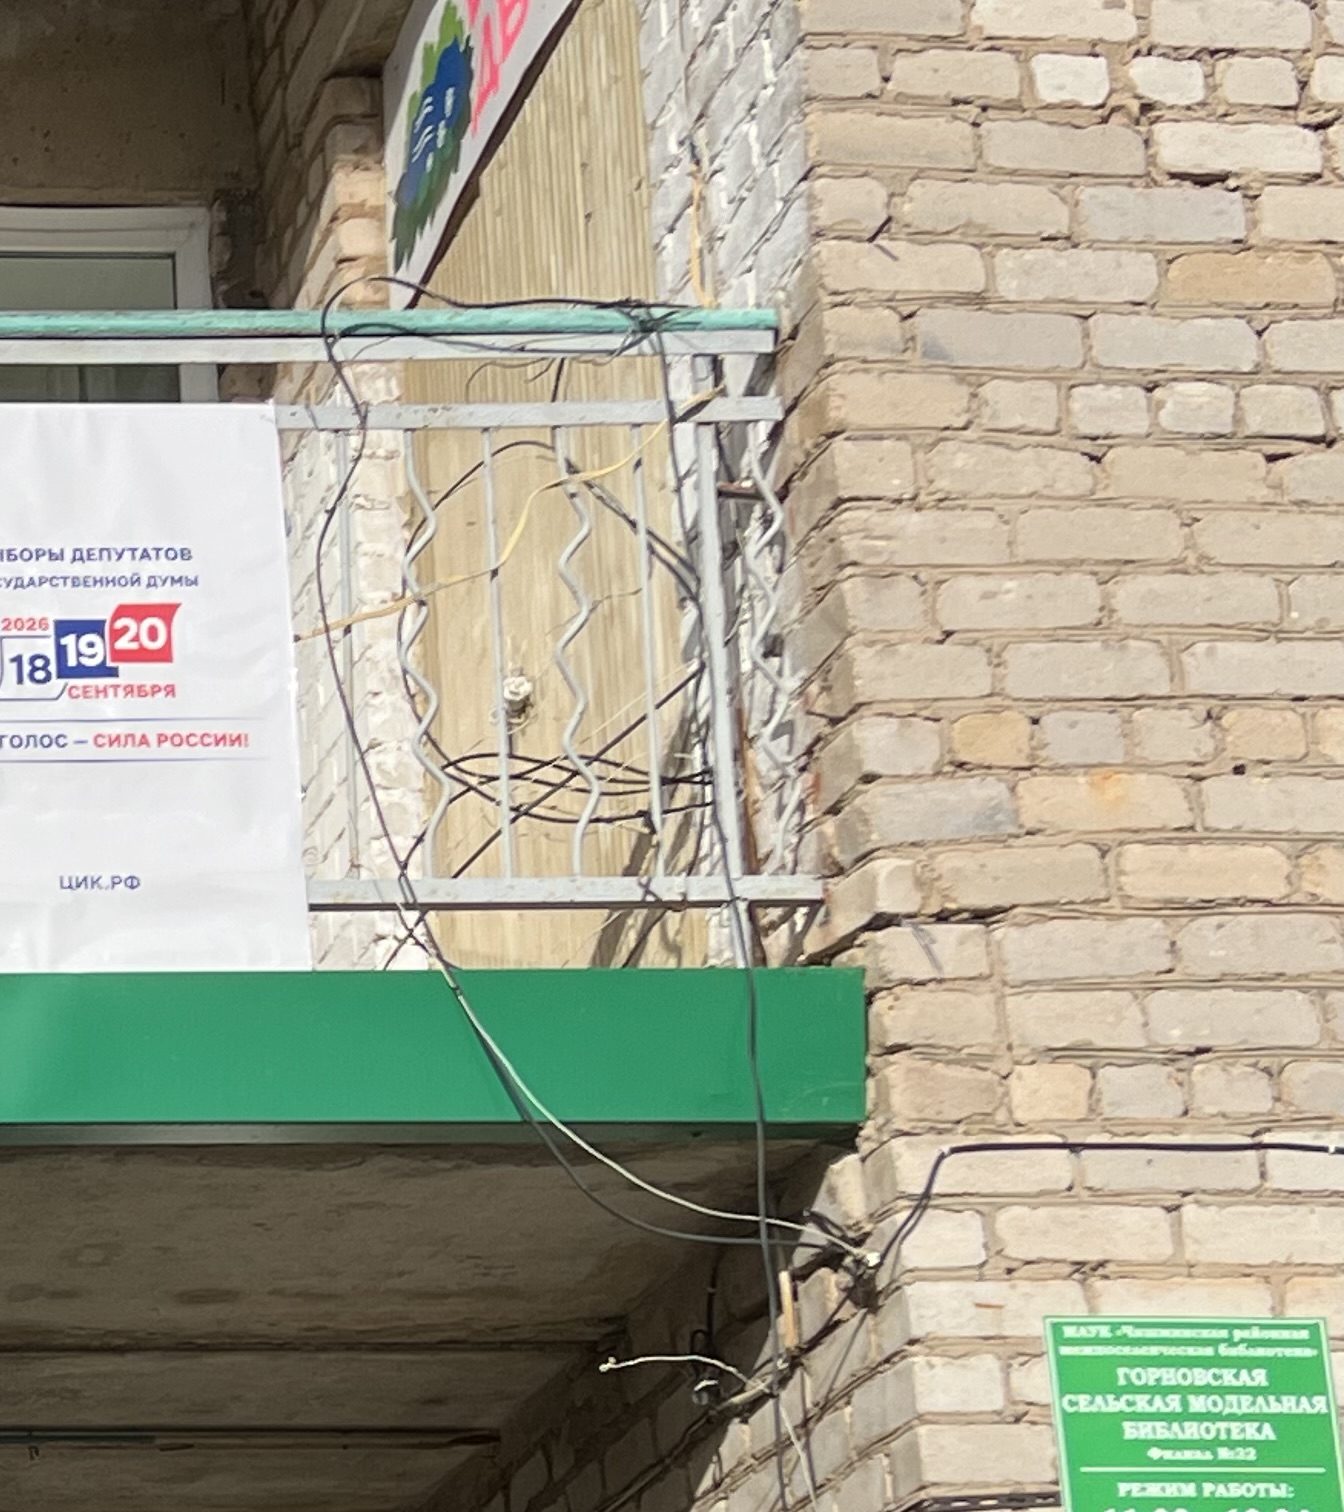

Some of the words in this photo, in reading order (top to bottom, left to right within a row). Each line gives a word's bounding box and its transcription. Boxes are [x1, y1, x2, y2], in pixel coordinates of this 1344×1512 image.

[70, 548, 193, 564] ДЕПУТАТОВ
[146, 575, 199, 589] ДУМЫ
[1, 617, 49, 632] 2026
[9, 653, 52, 685] 18
[60, 633, 105, 667] 19
[113, 617, 168, 650] 20
[67, 683, 176, 699] СЕНТЯБРЯ
[92, 733, 151, 749] СИЛА
[157, 732, 250, 748] РОССИИ!
[59, 874, 141, 892] ЦИК.РФ
[1116, 1367, 1269, 1387] ГОРНОВСКАЯ
[1062, 1394, 1182, 1413] СЕЛЬСКАЯ
[1188, 1394, 1329, 1416] МОДЕЛЬНАЯ
[1122, 1421, 1277, 1440] БИБЛИОТЕКА
[1117, 1482, 1197, 1498] РЕЖИМ
[1202, 1482, 1295, 1498] РАБОТЫ:
